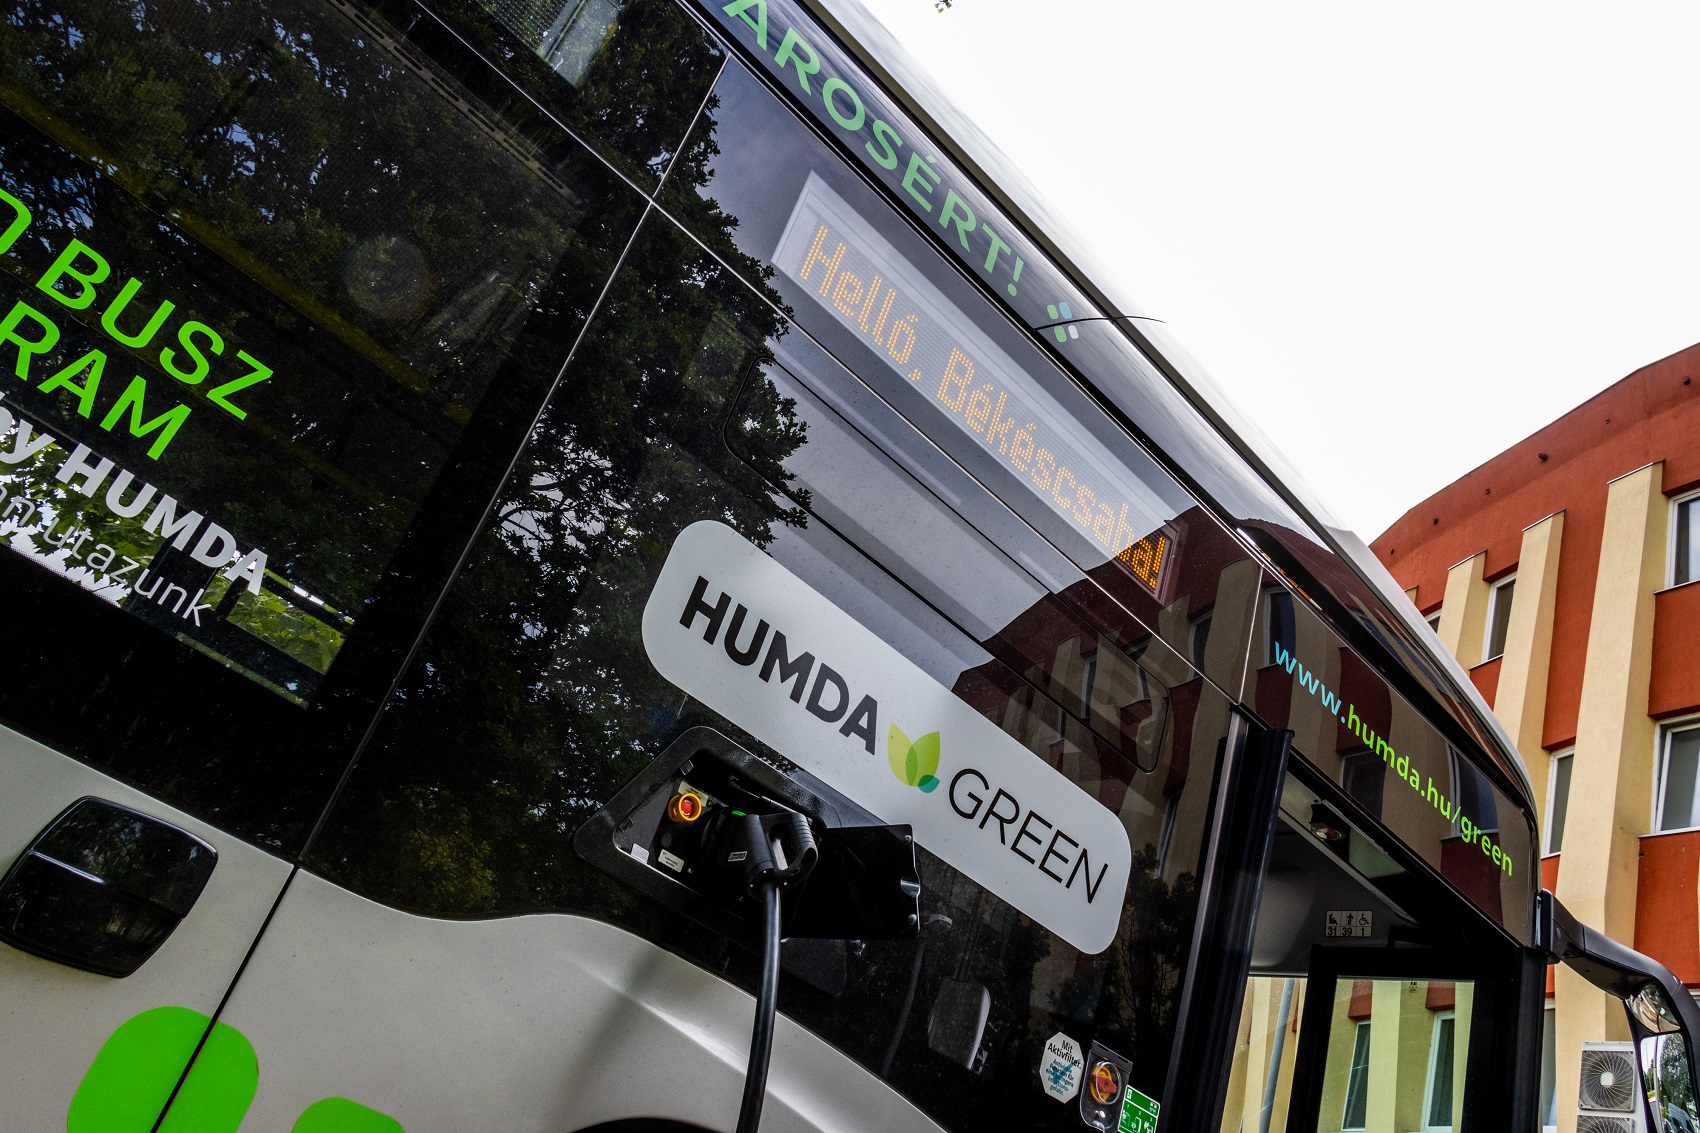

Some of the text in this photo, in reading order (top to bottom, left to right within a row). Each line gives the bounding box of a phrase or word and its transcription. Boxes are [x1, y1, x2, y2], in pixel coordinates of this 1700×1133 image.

[0, 300, 192, 461] RAM
[36, 238, 273, 420] BUSZ
[799, 225, 1167, 590] Helló, Békéscsaba!
[43, 517, 212, 628] utazunk
[55, 443, 268, 596] HUMDA
[679, 575, 1109, 904] HUMDA GREEN
[1274, 641, 1513, 876] www.humda.hu/green
[1327, 926, 1365, 937] 31 39 1
[1061, 1040, 1073, 1054] Mit
